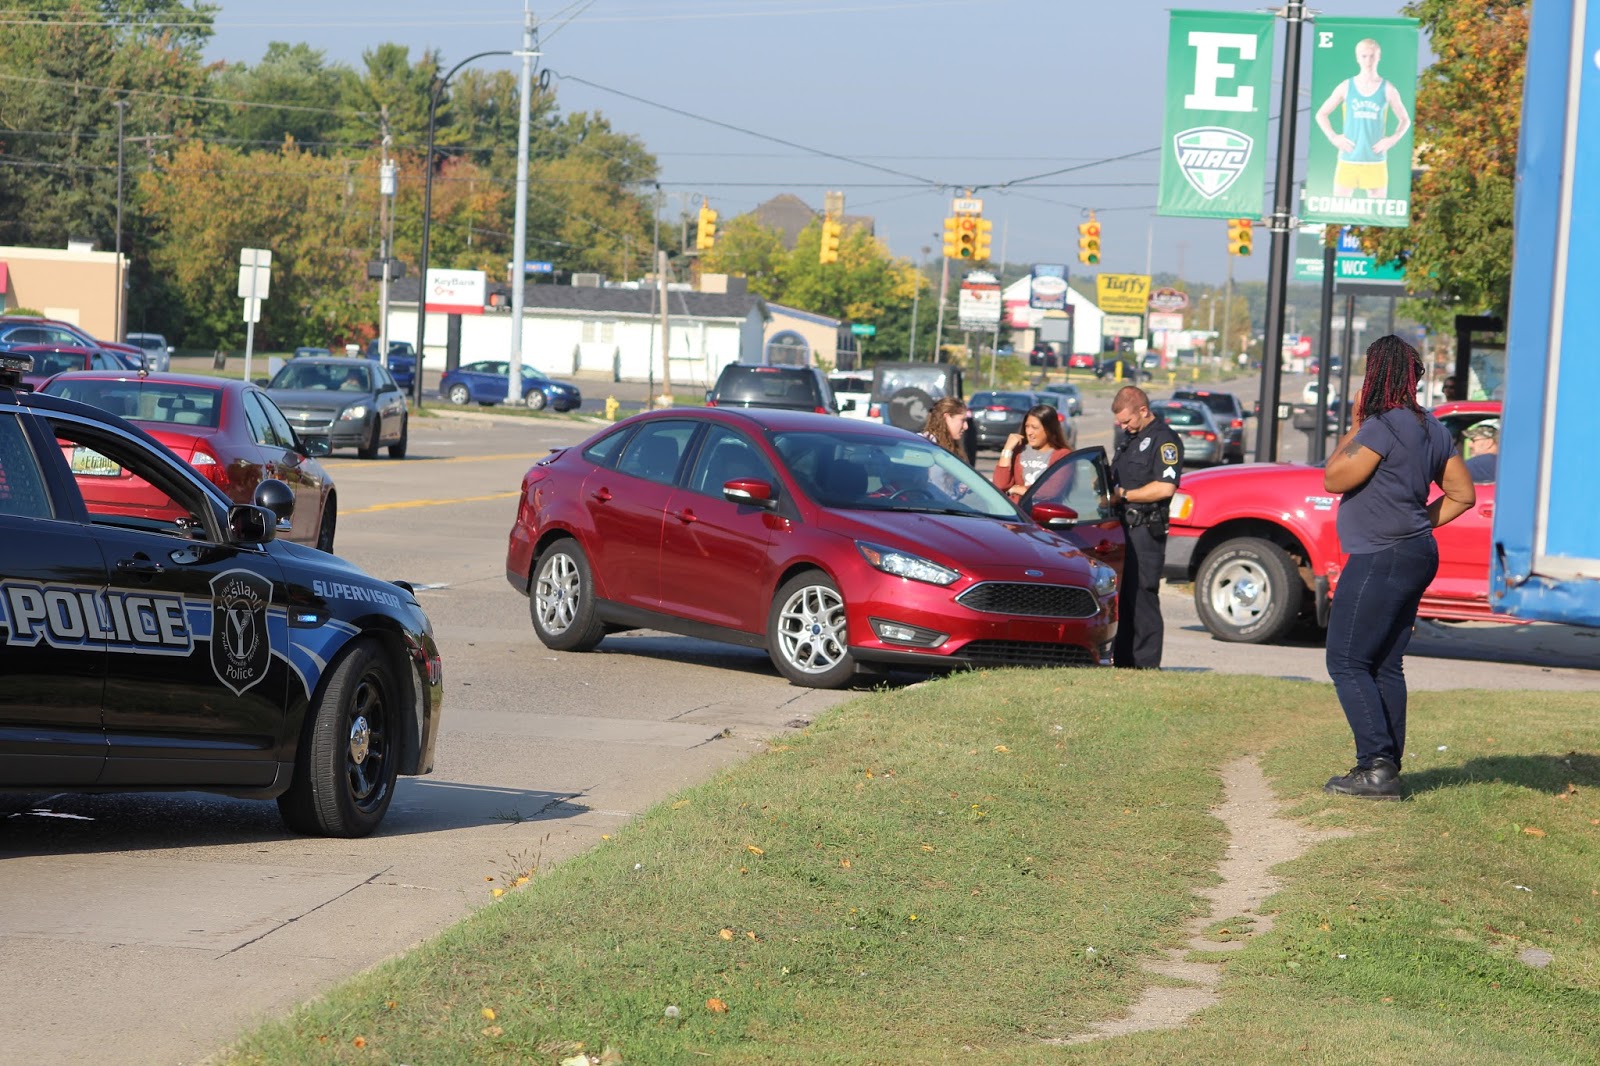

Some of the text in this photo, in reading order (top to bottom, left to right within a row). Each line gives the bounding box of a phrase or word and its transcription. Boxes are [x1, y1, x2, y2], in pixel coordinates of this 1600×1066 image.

[1318, 32, 1334, 48] E
[1184, 31, 1257, 112] E
[1180, 149, 1245, 170] MAC
[1307, 196, 1407, 217] COMMITTED
[1341, 259, 1368, 275] WCC
[434, 277, 476, 287] KeyBank
[1103, 275, 1147, 293] Tuffy
[312, 579, 402, 610] SUPERVISOR
[6, 585, 190, 647] POLICE
[226, 664, 254, 680] Police
